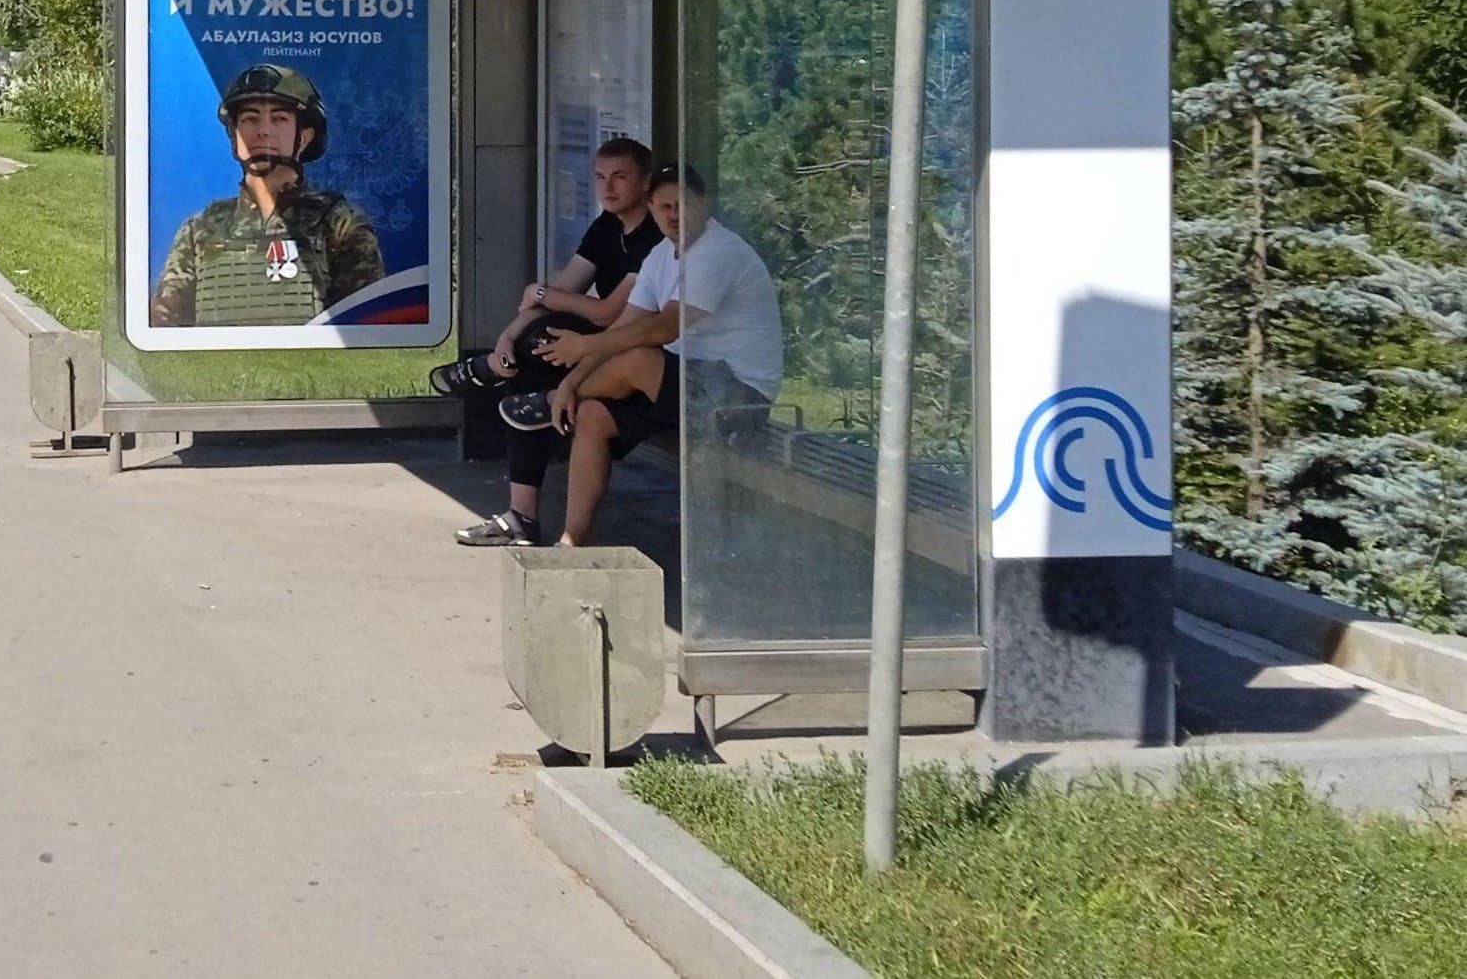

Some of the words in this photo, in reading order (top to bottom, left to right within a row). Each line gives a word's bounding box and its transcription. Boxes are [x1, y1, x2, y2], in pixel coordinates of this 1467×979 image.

[201, 30, 304, 45] АБДУЛАЗИЗ
[309, 30, 382, 44] ЮСУПОВ
[262, 46, 321, 57] ЛЕЙТЕНАНТ
